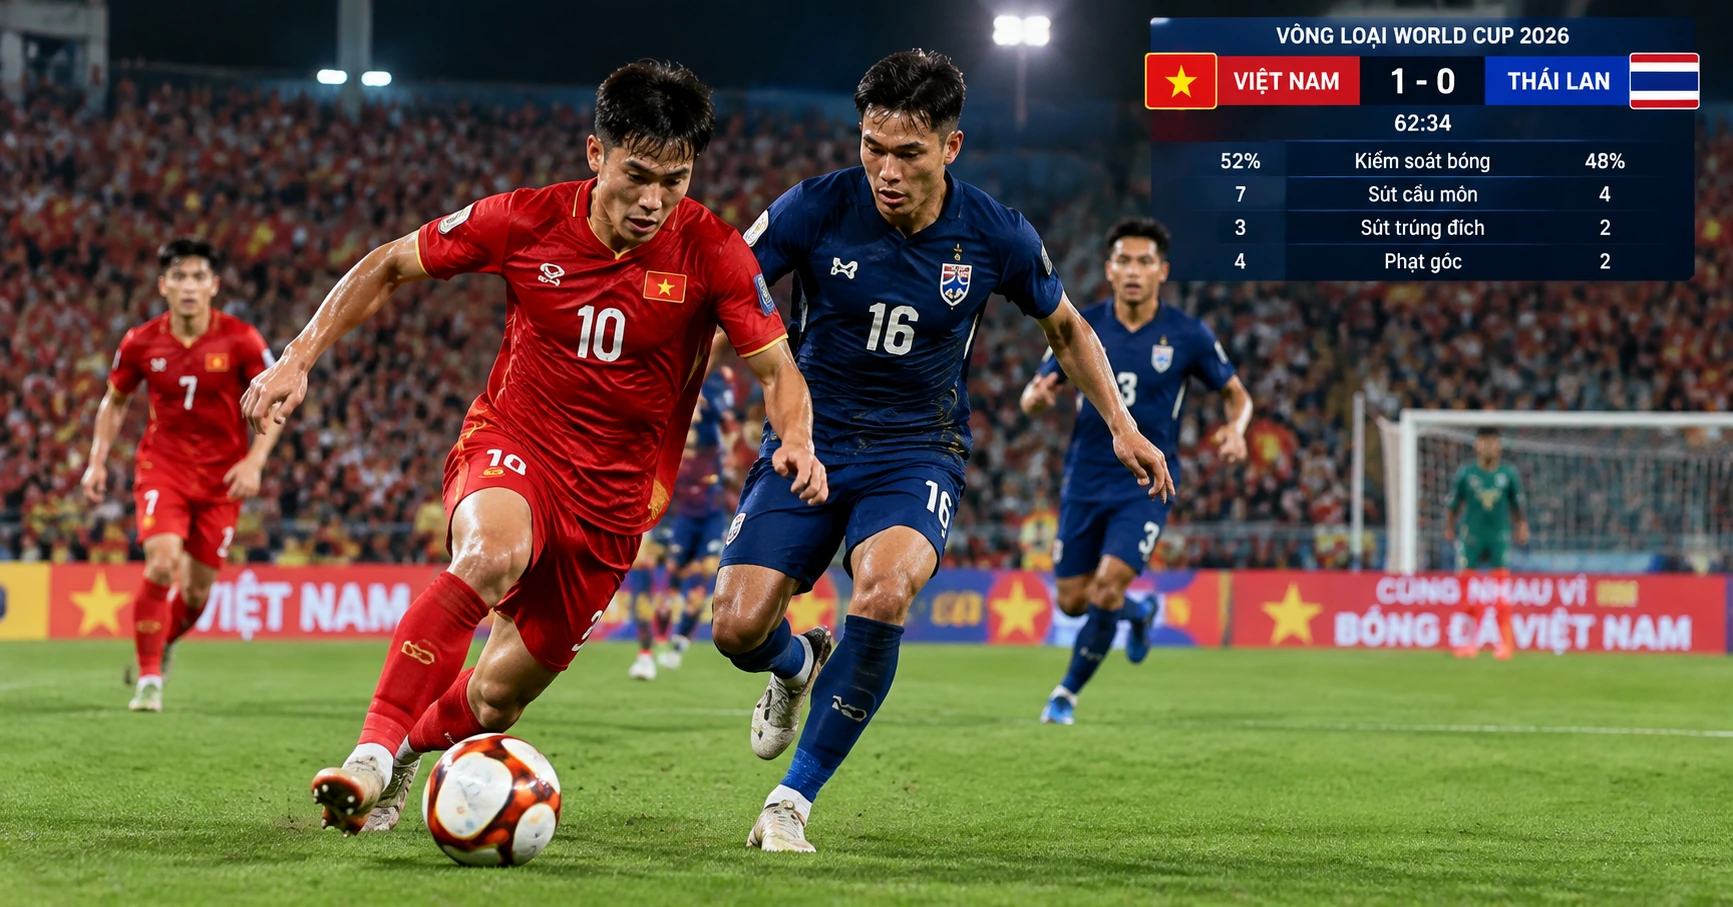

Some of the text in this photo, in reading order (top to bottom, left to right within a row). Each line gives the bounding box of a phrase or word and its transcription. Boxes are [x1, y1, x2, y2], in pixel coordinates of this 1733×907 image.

[577, 304, 626, 362] 10
[867, 302, 919, 355] 16
[178, 375, 198, 410] 7
[486, 448, 527, 476] 10
[925, 479, 952, 529] 16
[1138, 521, 1160, 554] 3
[300, 582, 411, 632] NAM
[1510, 606, 1597, 655] VIỆT
[1602, 614, 1693, 651] NAM
